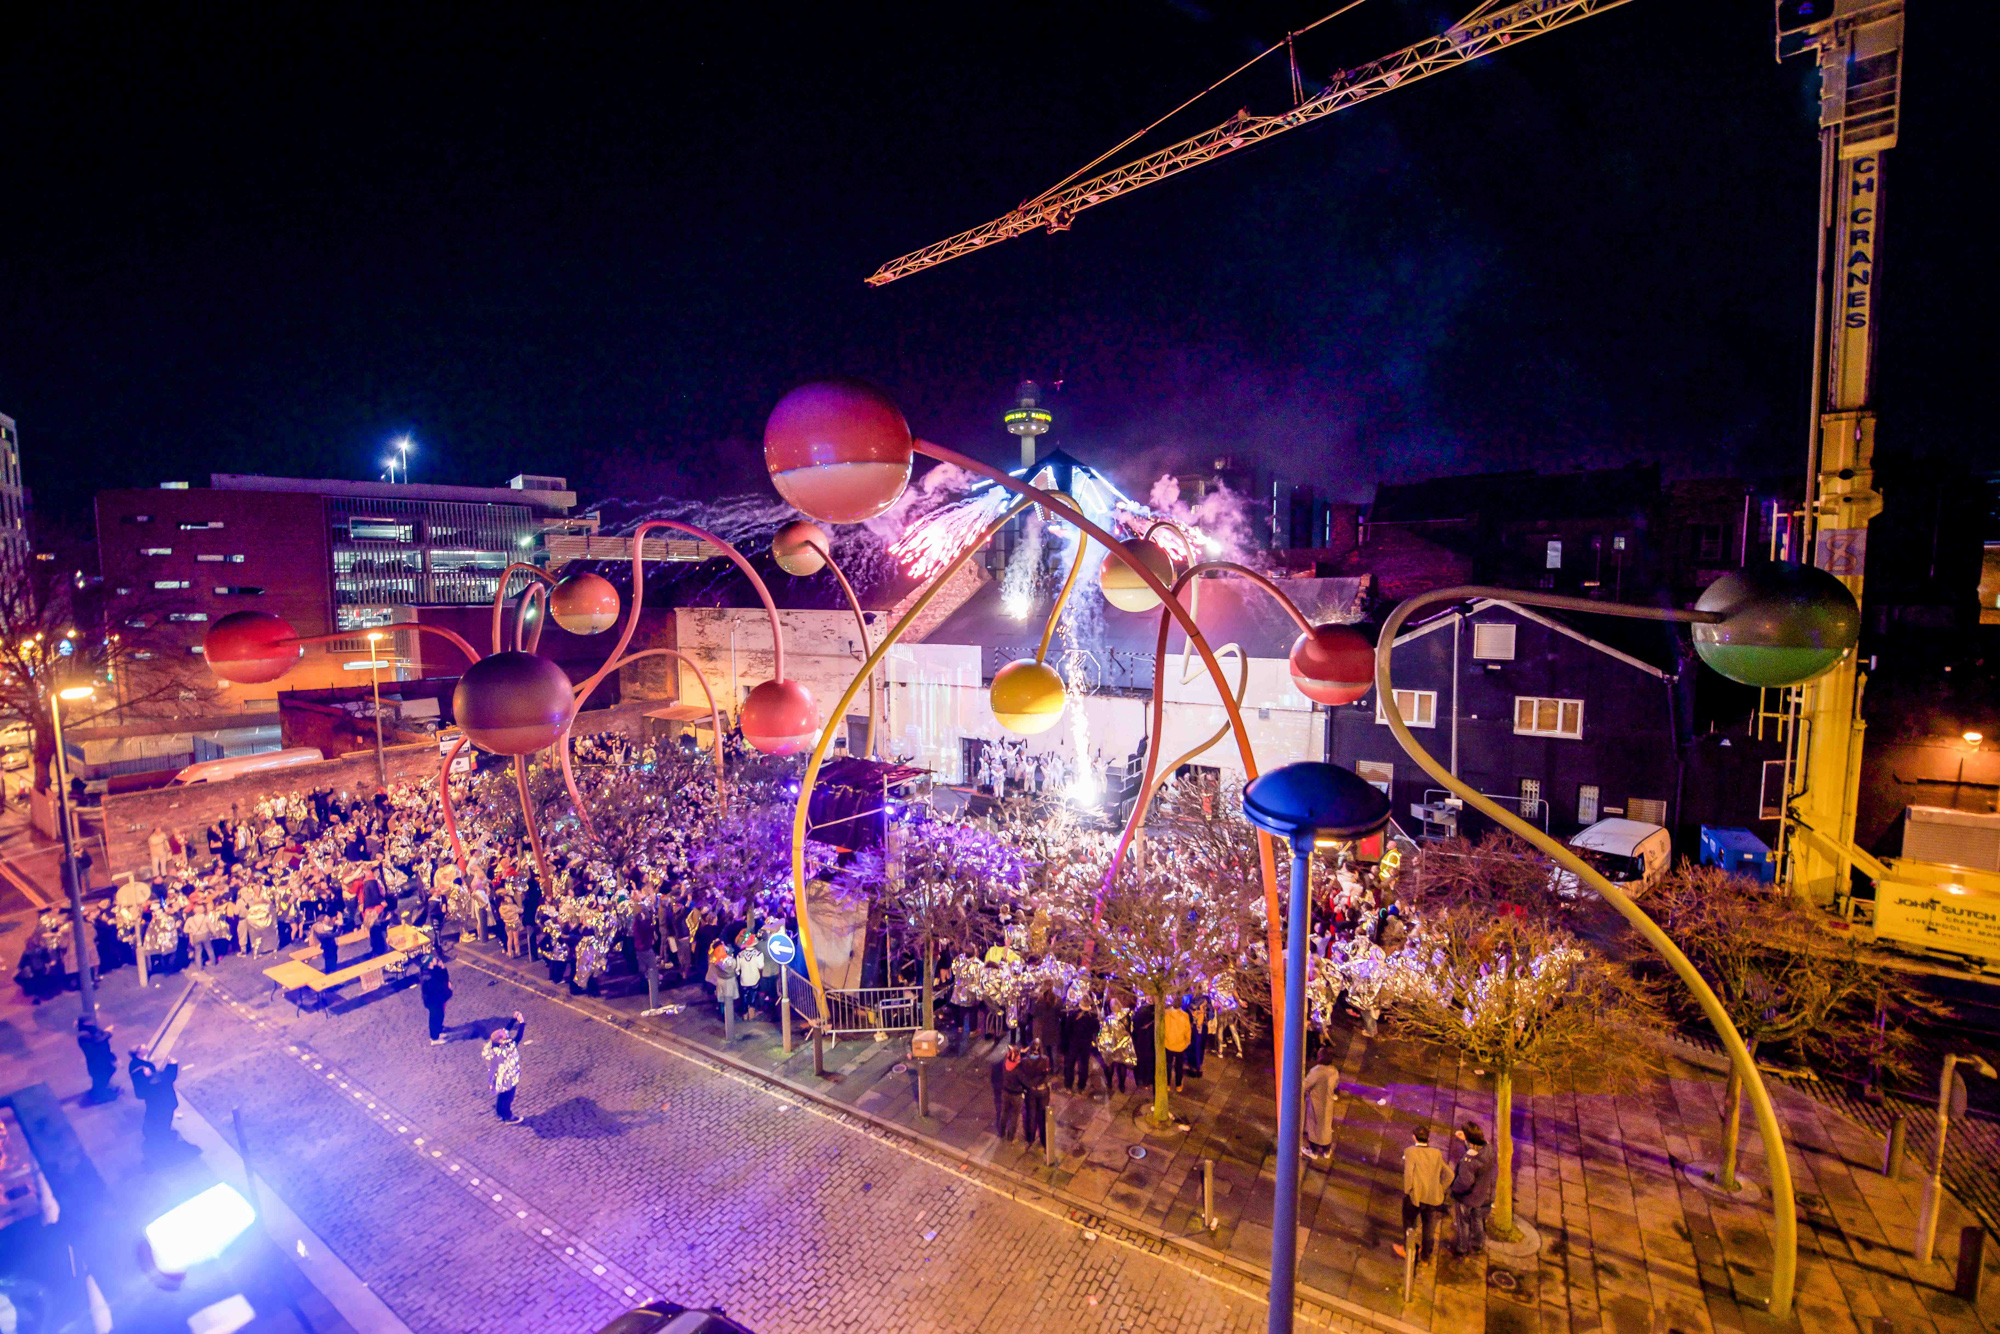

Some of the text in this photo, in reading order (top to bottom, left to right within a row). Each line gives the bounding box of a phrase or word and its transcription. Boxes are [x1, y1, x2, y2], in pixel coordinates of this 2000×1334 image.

[1460, 14, 1512, 43] JOHN
[1846, 207, 1872, 328] CRANES
[1894, 898, 1996, 921] JOHN SUTCH
[1906, 917, 1960, 931] LIVERPOOL
